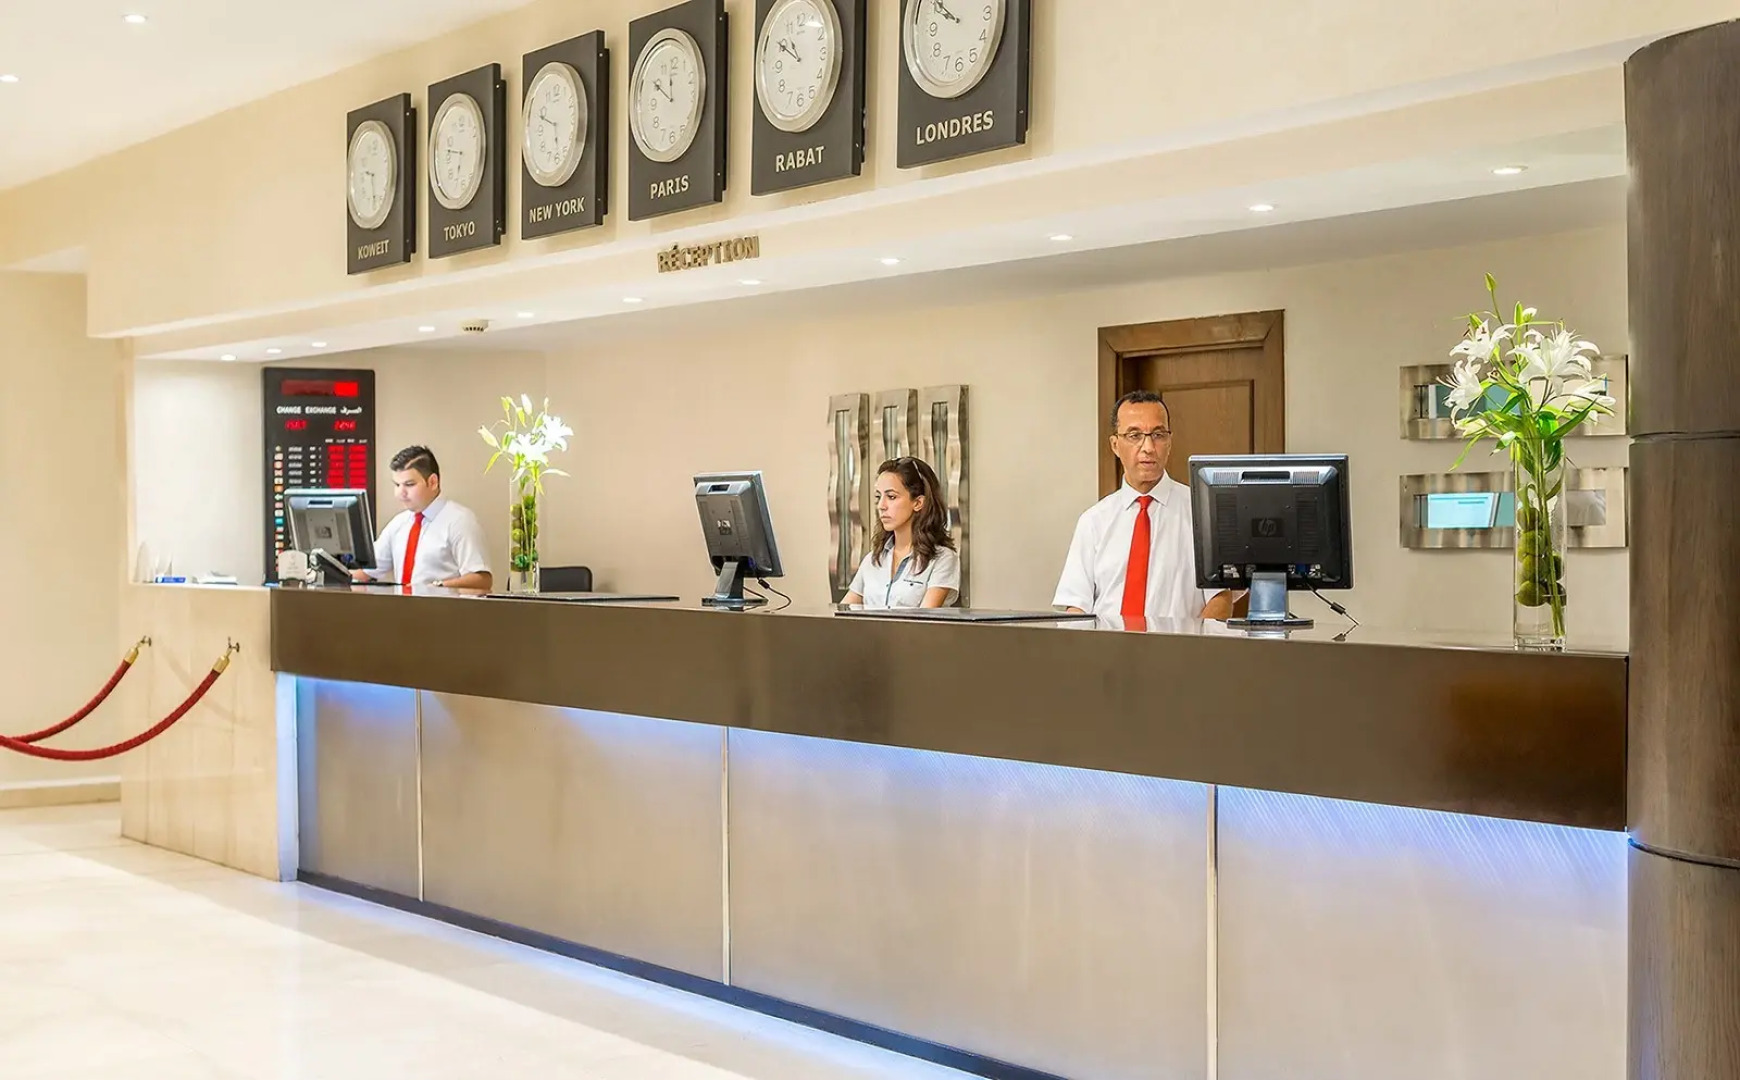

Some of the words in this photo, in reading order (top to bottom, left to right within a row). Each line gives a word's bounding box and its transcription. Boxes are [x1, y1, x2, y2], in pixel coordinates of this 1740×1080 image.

[983, 6, 991, 20] 3
[929, 22, 937, 37] 9
[979, 29, 986, 42] 4
[933, 42, 941, 57] 8
[969, 48, 977, 63] 5
[775, 60, 782, 73] 9
[943, 55, 950, 71] 7
[955, 57, 964, 72] 6
[778, 79, 786, 93] 8
[808, 85, 816, 99] 5
[796, 93, 804, 107] 6
[916, 110, 994, 145] LONDRES
[775, 146, 825, 172] RABAT
[650, 175, 689, 200] PARIS
[529, 203, 553, 223] NEW
[555, 196, 585, 217] YORK
[443, 221, 475, 241] TOKYO
[357, 239, 389, 260] KOWEIT
[657, 236, 759, 273] RÉCEPTION
[276, 406, 302, 414] CHANGE
[305, 406, 336, 414] EXCHANGE
